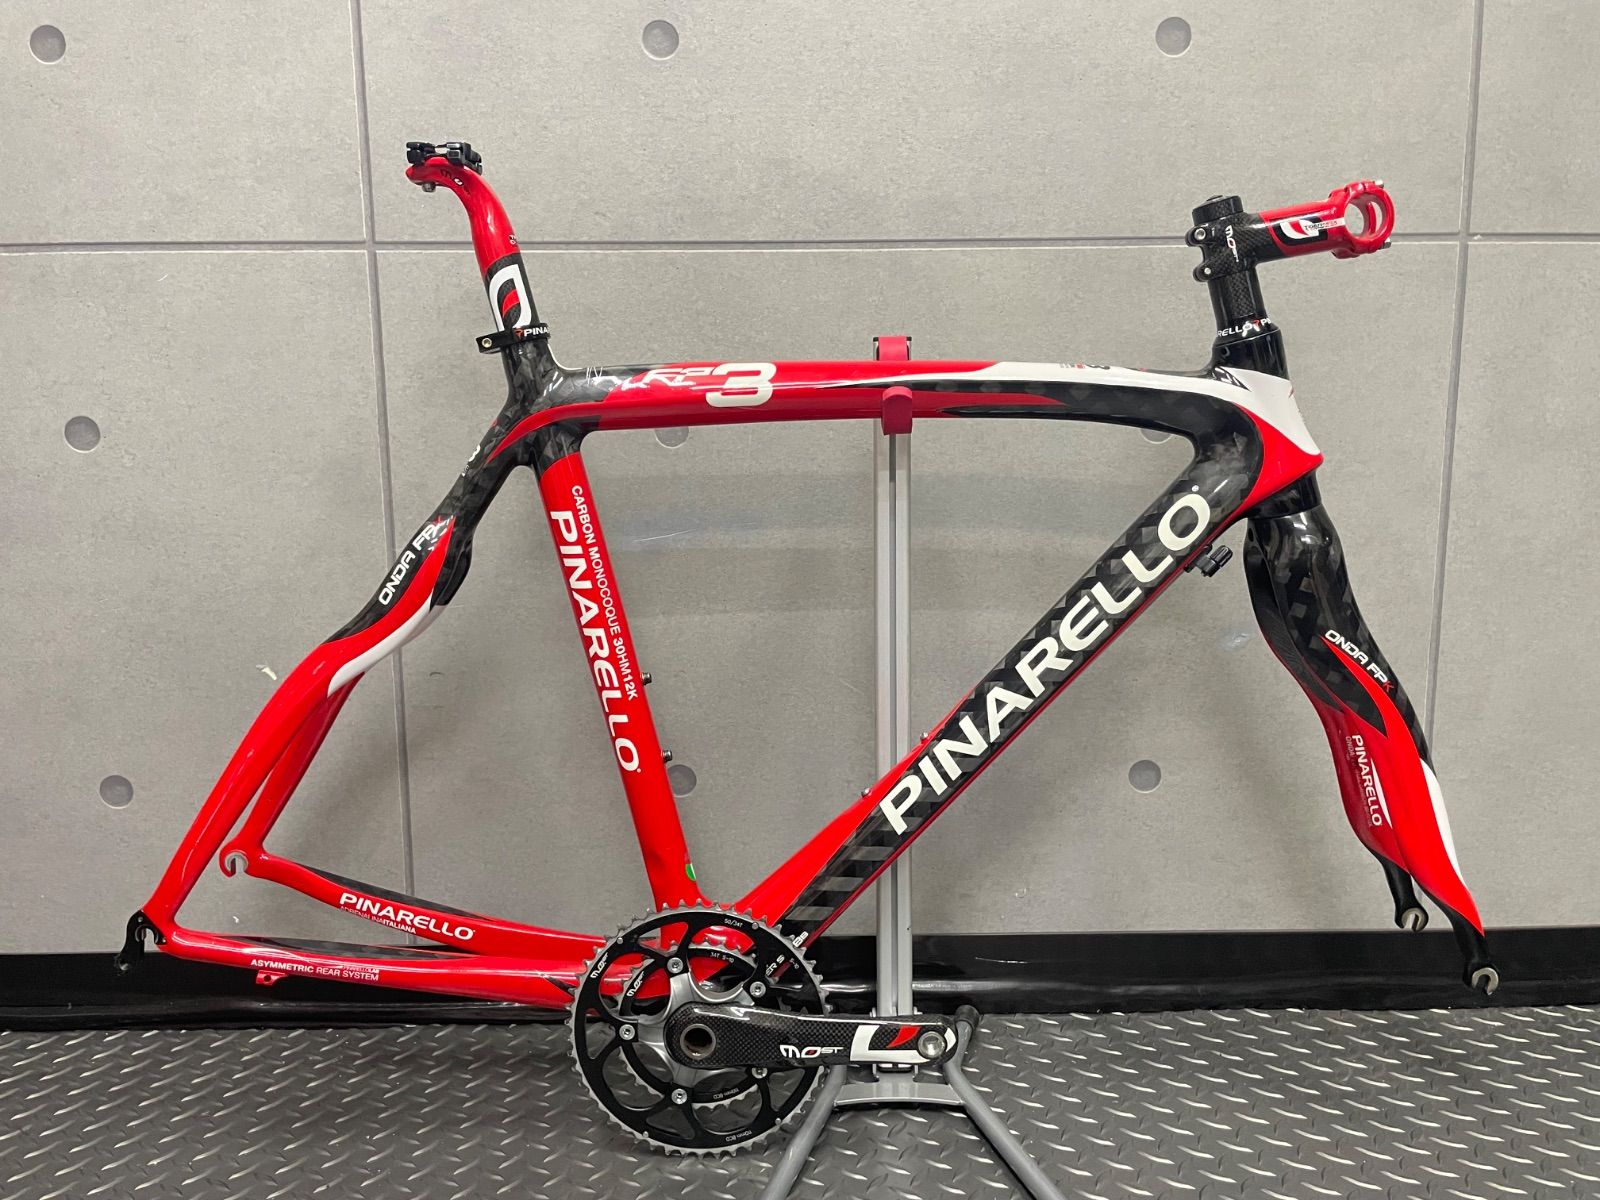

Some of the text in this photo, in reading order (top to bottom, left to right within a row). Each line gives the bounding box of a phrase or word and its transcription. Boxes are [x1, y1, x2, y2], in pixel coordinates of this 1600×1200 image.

[378, 550, 416, 605] ONDA
[572, 485, 638, 701] CARBON MONOCOQUE 30HM12K
[550, 510, 641, 773] PINARELLO
[879, 488, 1211, 836] PINARELLO
[1324, 629, 1369, 665] ONDA
[1352, 734, 1383, 827] PINARELLO
[339, 892, 476, 941] PINARELLO
[250, 959, 380, 982] ASYMMETRIC REAR SYSTEM
